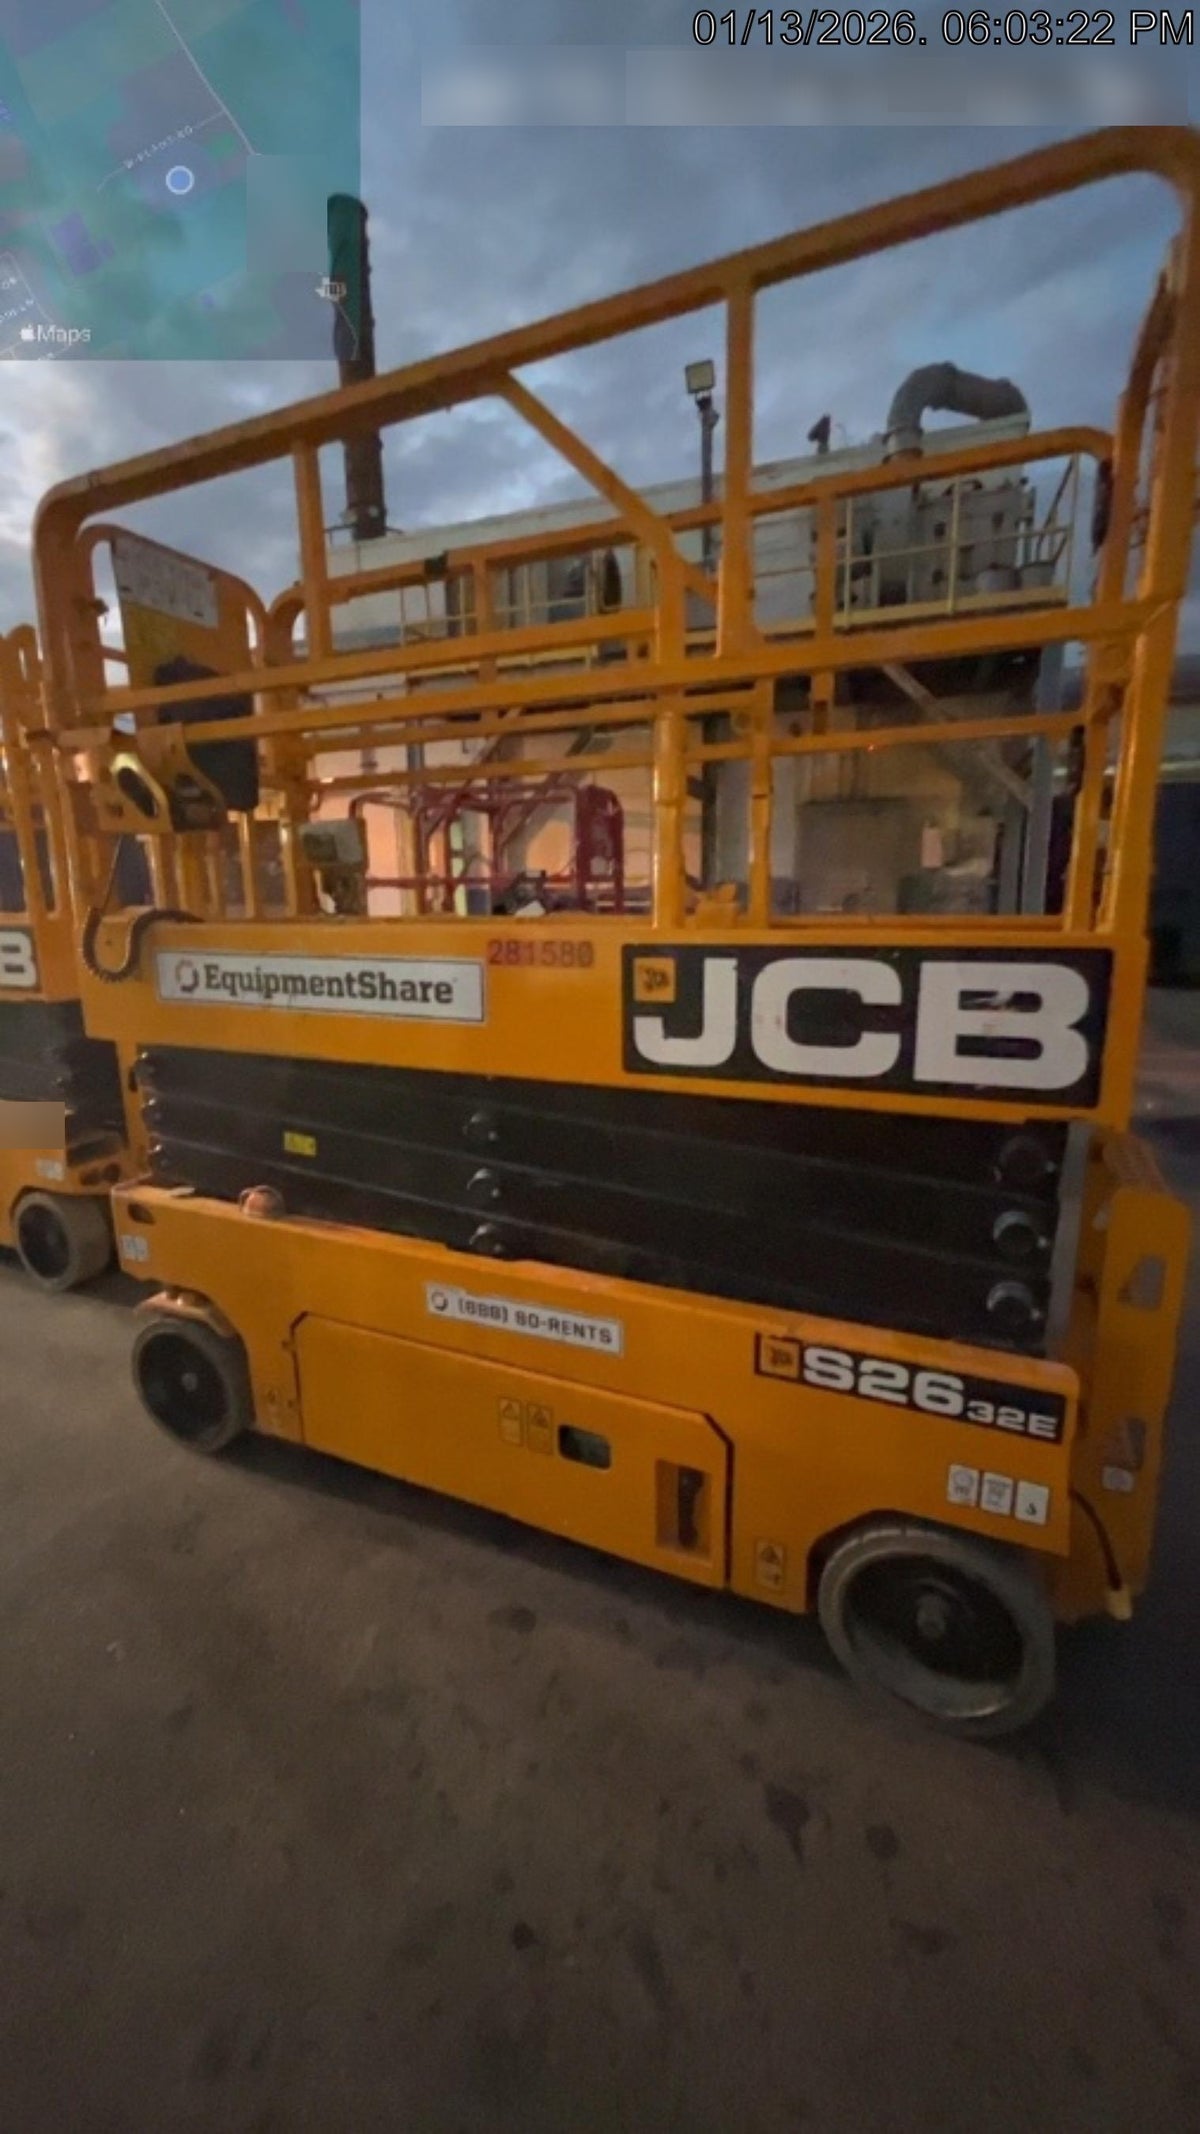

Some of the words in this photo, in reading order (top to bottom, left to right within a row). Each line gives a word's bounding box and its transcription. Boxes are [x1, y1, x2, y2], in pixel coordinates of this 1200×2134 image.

[205, 964, 453, 1004] EquipmentShare
[487, 939, 595, 968] 281580
[634, 957, 1090, 1089] JCB
[803, 1348, 964, 1416] S26
[966, 1400, 1058, 1438] 32E
